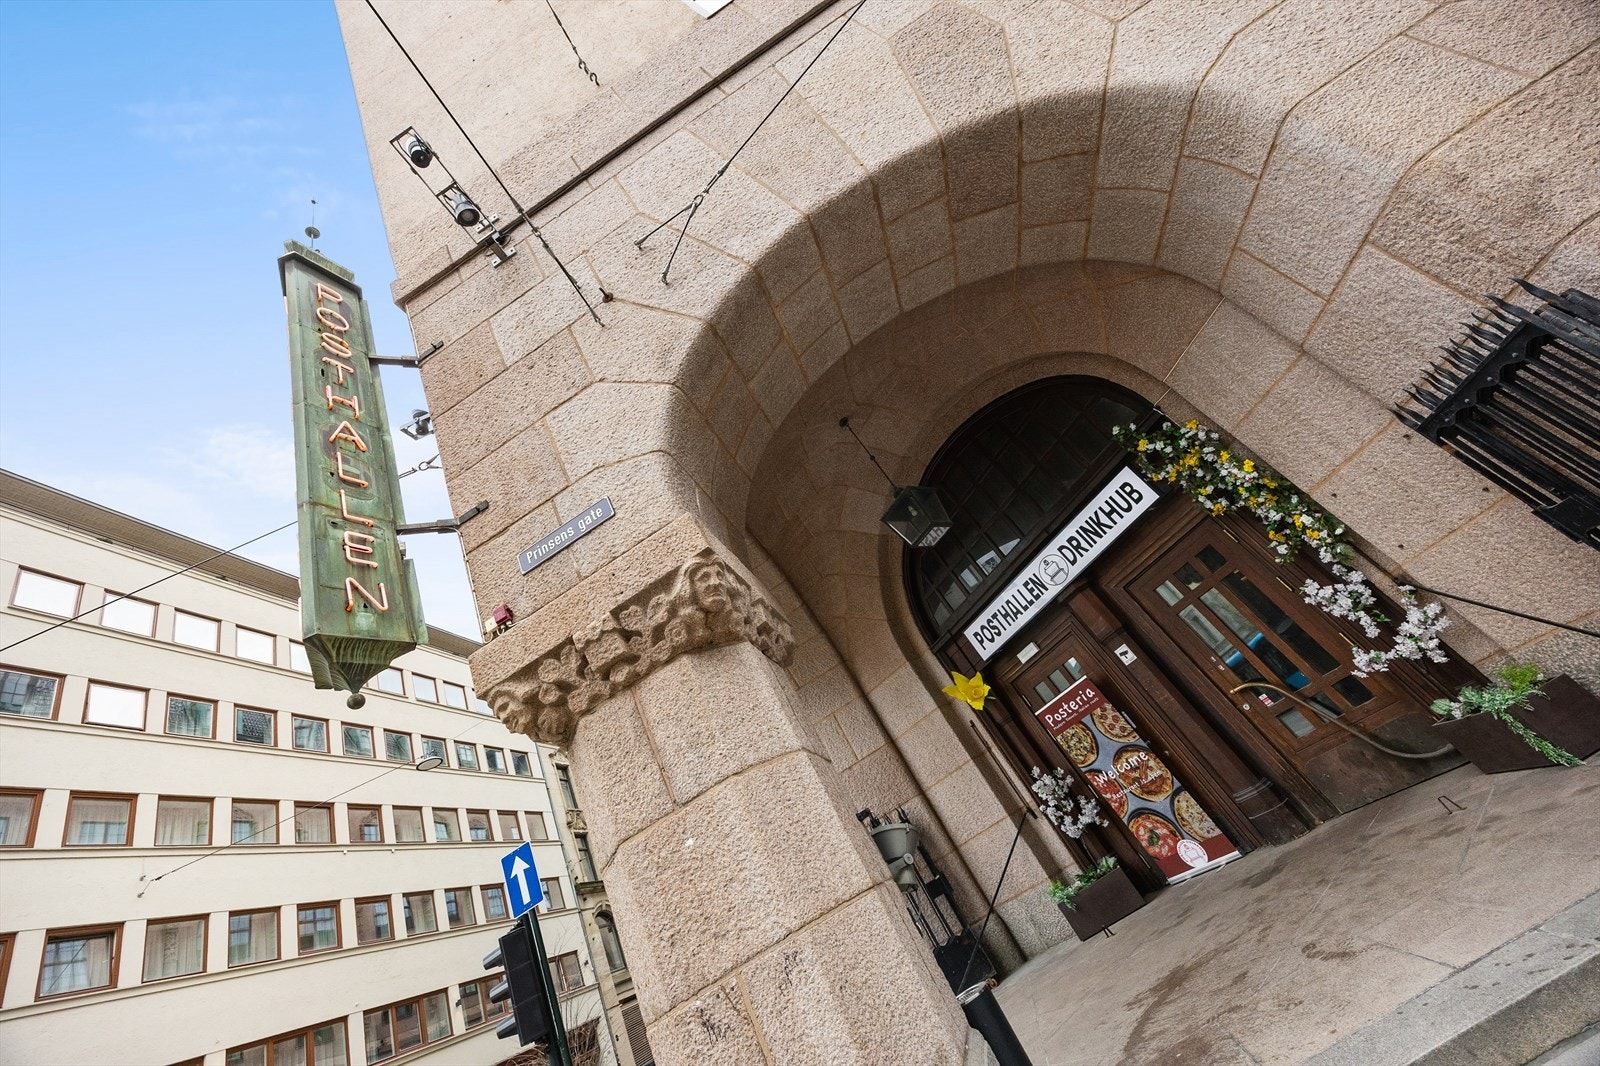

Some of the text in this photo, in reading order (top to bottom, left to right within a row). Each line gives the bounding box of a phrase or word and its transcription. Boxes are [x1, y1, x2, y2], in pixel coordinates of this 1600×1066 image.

[316, 281, 388, 613] POSTHALLEN
[526, 507, 603, 564] Prinsens gate
[972, 481, 1144, 651] POSTHALLEN DRINKHUB
[1044, 687, 1096, 727] Posteria
[1094, 750, 1149, 788] Welcome
